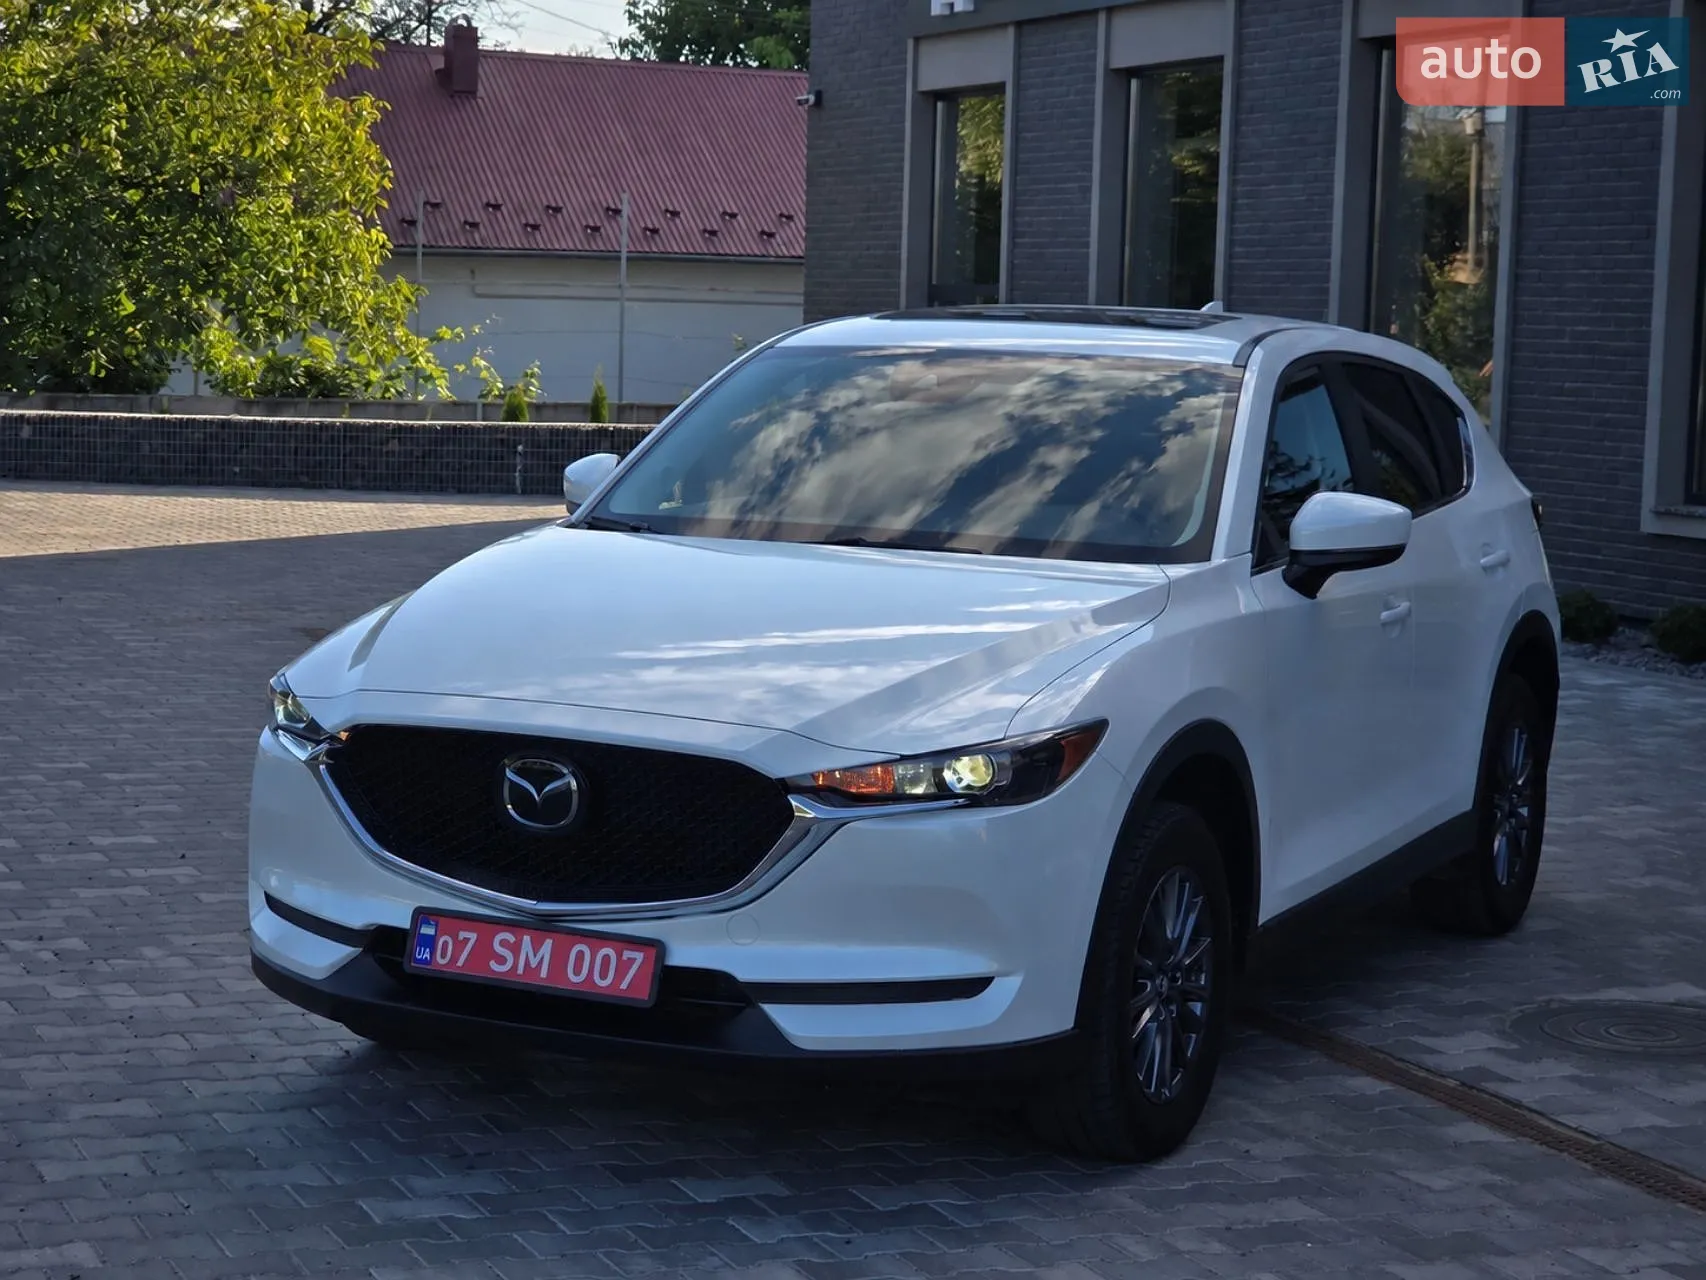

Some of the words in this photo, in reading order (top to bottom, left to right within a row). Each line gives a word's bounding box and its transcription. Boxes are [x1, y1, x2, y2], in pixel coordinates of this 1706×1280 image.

[415, 946, 431, 961] UA
[435, 931, 478, 965] 07
[489, 931, 554, 978] SM
[566, 943, 645, 990] 007
